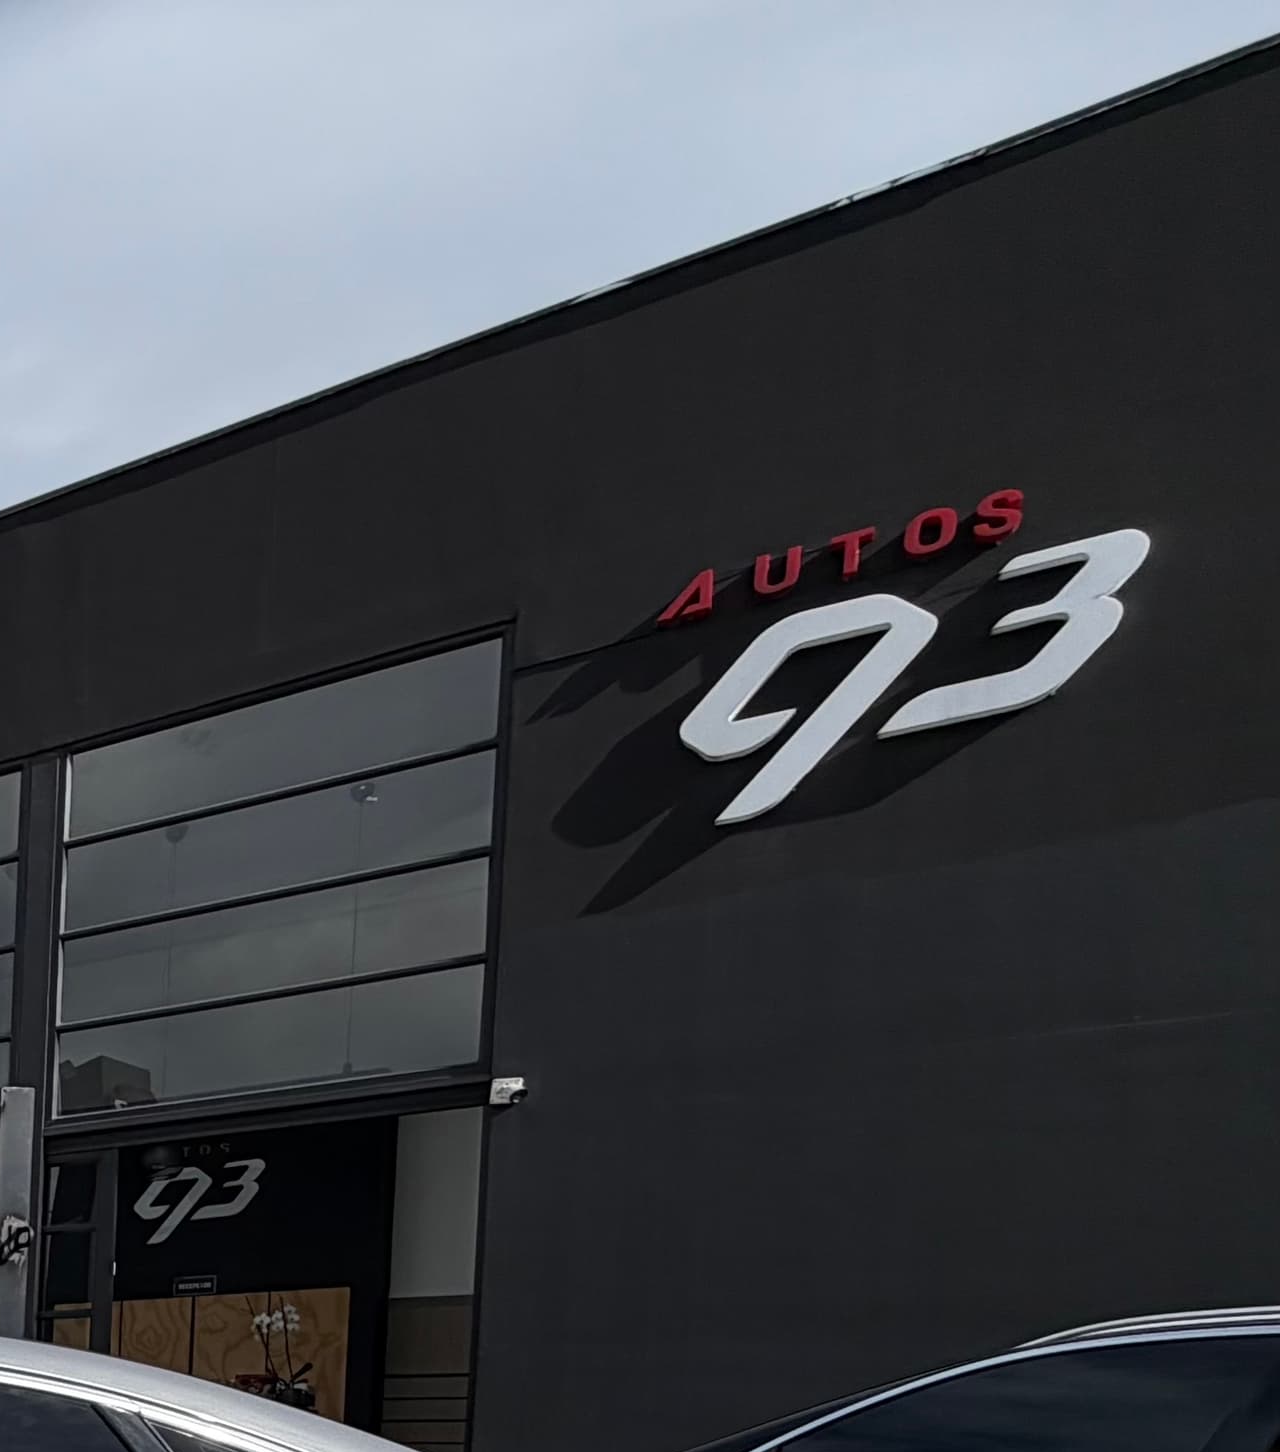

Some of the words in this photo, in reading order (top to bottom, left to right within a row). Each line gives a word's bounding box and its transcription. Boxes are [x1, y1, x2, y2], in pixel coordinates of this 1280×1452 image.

[656, 488, 1025, 628] AUTOS
[679, 528, 1151, 826] 93
[133, 1158, 266, 1245] 93
